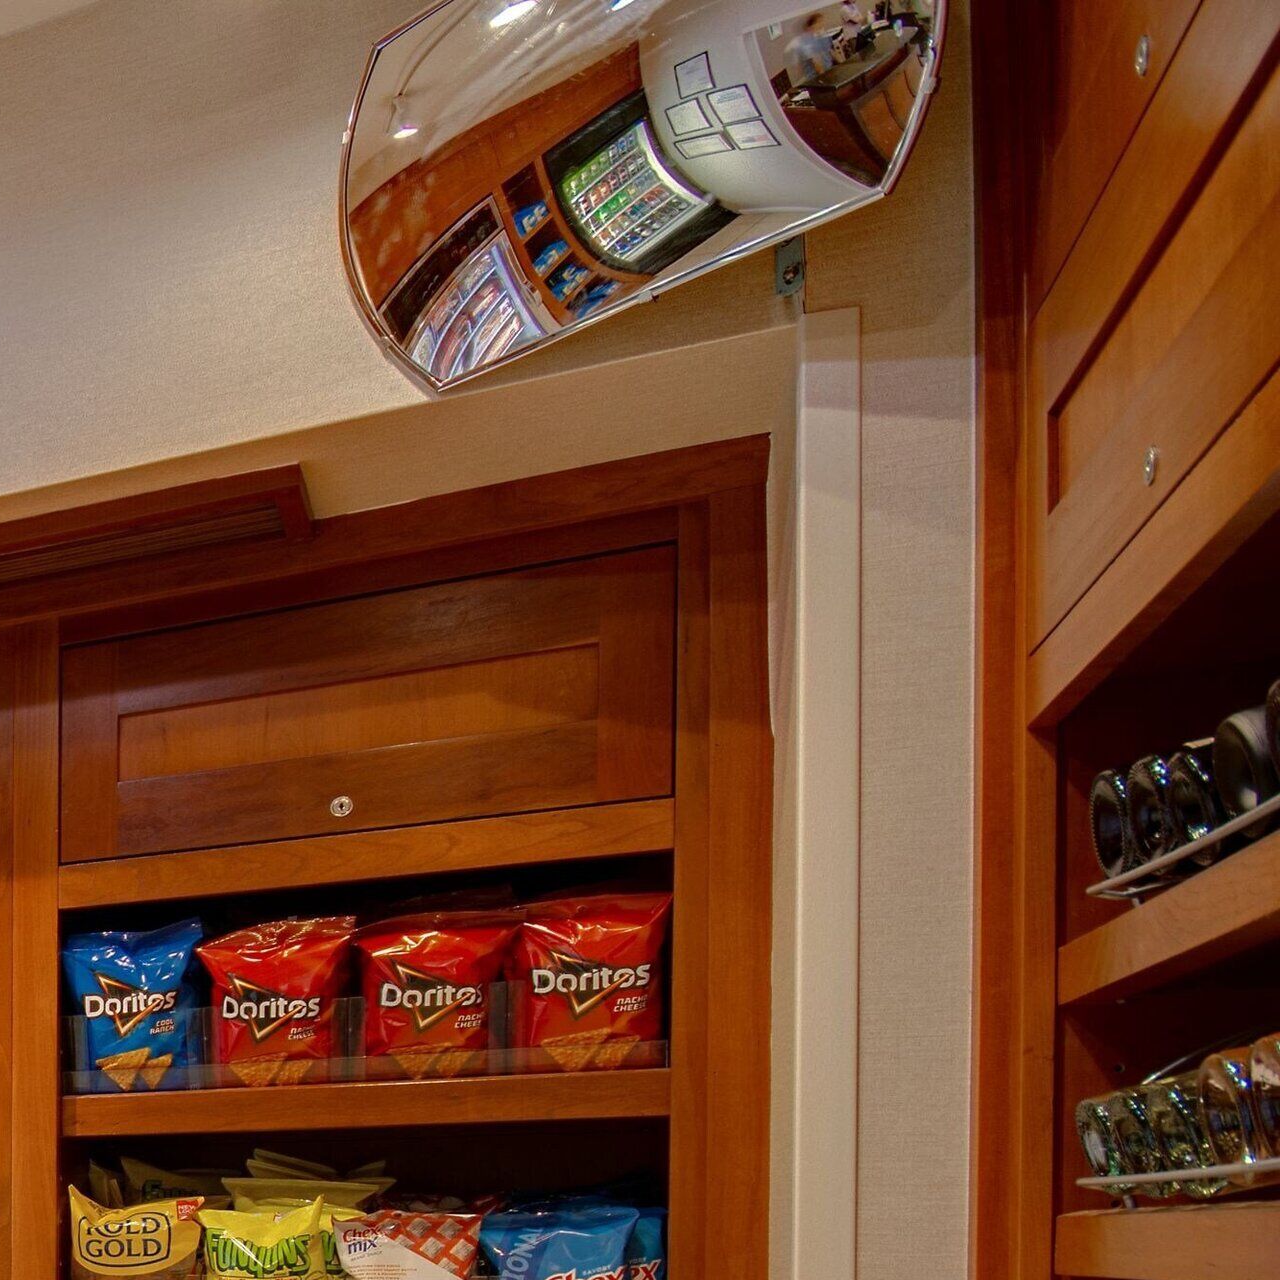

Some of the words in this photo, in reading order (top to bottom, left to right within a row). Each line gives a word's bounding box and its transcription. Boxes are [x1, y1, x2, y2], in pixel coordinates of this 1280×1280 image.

[532, 964, 651, 994] Doritos
[84, 990, 178, 1018] Doritos
[380, 983, 483, 1008] Doritos
[222, 996, 321, 1020] Doritos
[613, 1002, 648, 1012] CHEESE
[149, 1025, 175, 1035] RANCH
[155, 1018, 175, 1027] COOL
[343, 1226, 381, 1243] Chex
[86, 1238, 163, 1259] GOLD
[346, 1237, 379, 1255] mix
